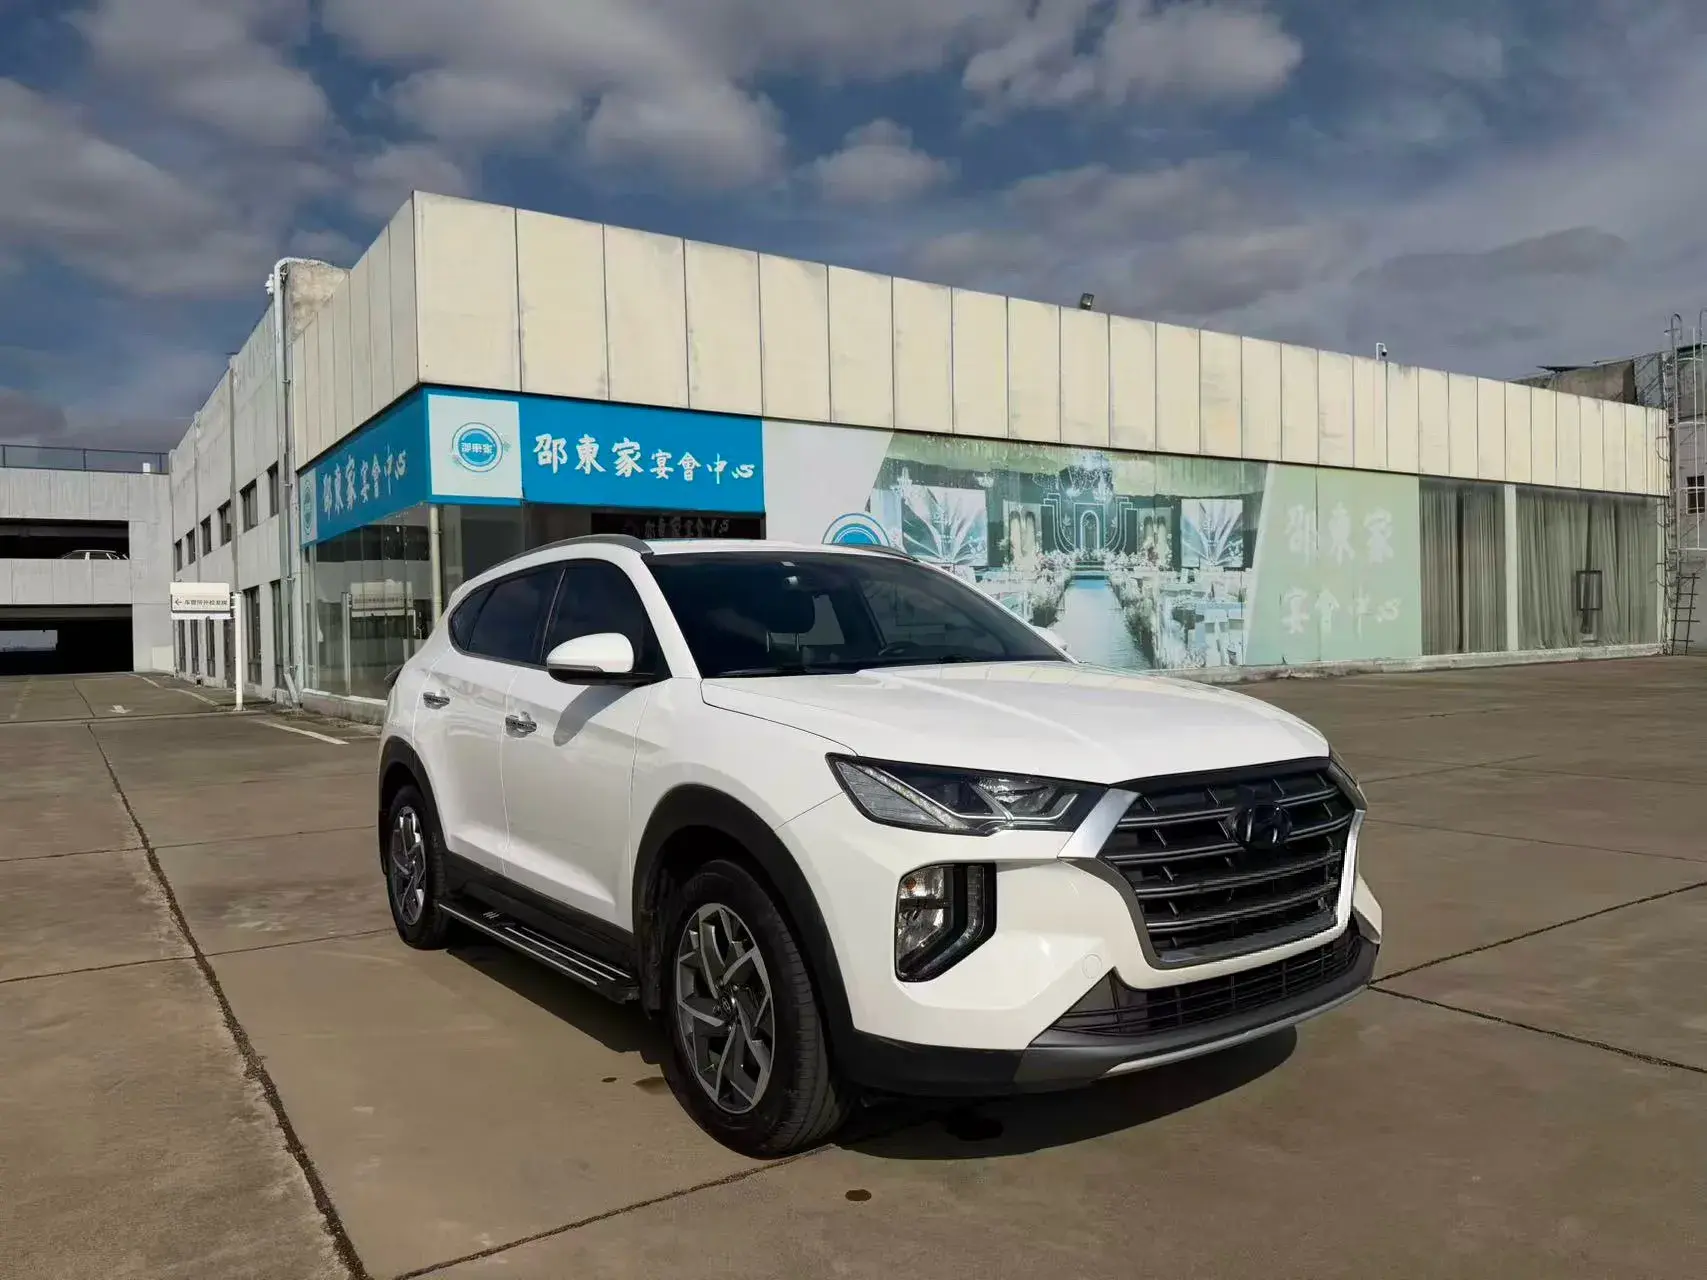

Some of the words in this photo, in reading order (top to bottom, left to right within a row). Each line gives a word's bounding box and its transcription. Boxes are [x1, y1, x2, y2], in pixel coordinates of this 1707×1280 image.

[533, 433, 755, 485] 邵東家宴會中心
